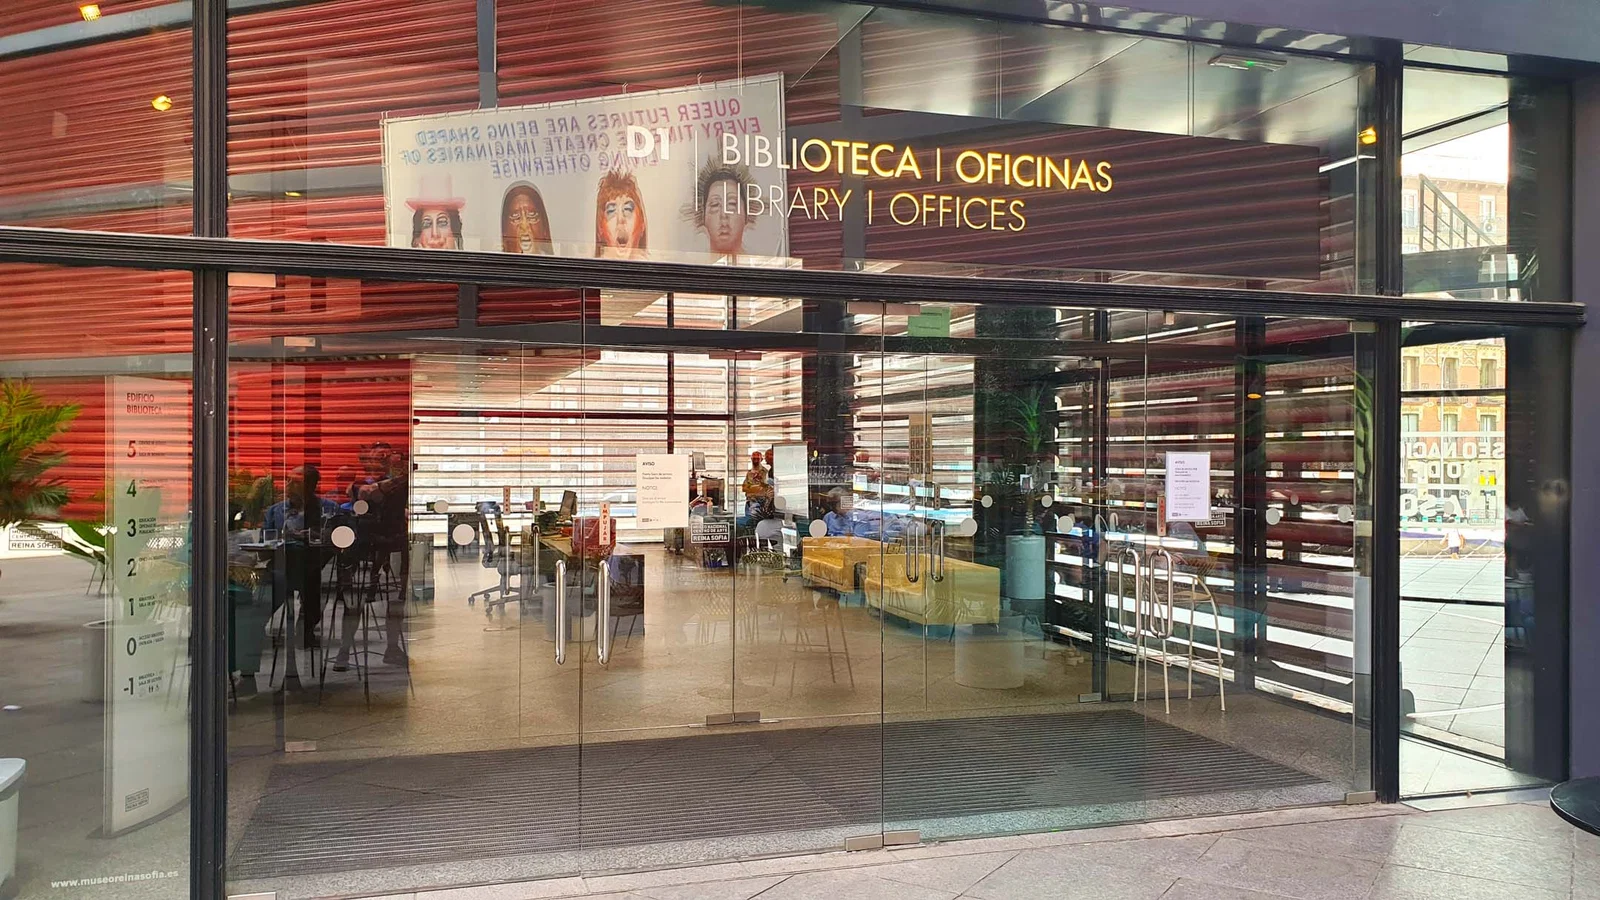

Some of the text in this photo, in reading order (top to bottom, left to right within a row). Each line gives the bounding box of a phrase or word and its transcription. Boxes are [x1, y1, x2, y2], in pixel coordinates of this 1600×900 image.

[626, 126, 669, 161] D1
[722, 132, 1113, 193] BIBLIOTECA OFICINAS
[723, 181, 1026, 232] LIBRARY OFFICES
[126, 392, 155, 402] EDIFICIO
[126, 404, 162, 415] BIBLIOTECA
[127, 440, 136, 458] 5
[126, 479, 137, 497] 4
[127, 518, 136, 537] 3
[127, 558, 137, 577] 2
[129, 597, 134, 616] 1
[127, 637, 137, 656] 0
[123, 677, 134, 695] -1
[51, 870, 179, 888] www.museoreinasofia.es
